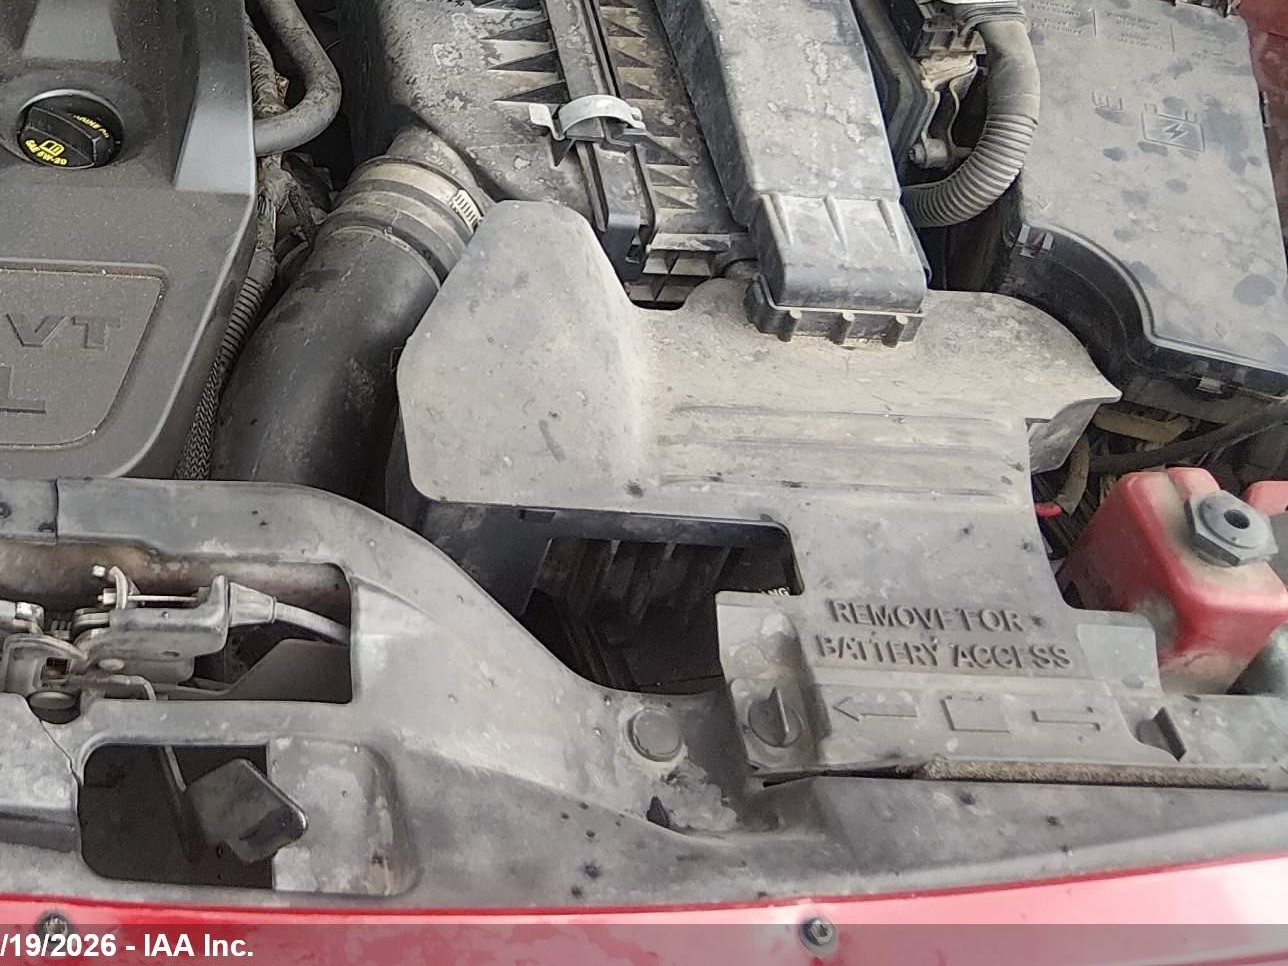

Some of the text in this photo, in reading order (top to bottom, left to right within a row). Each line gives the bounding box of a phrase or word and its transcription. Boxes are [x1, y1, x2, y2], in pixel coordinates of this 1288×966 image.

[25, 139, 68, 166] SAE 5W-20
[827, 599, 1025, 632] REMOVE FOR
[816, 634, 1073, 669] BATTERY ACCESS
